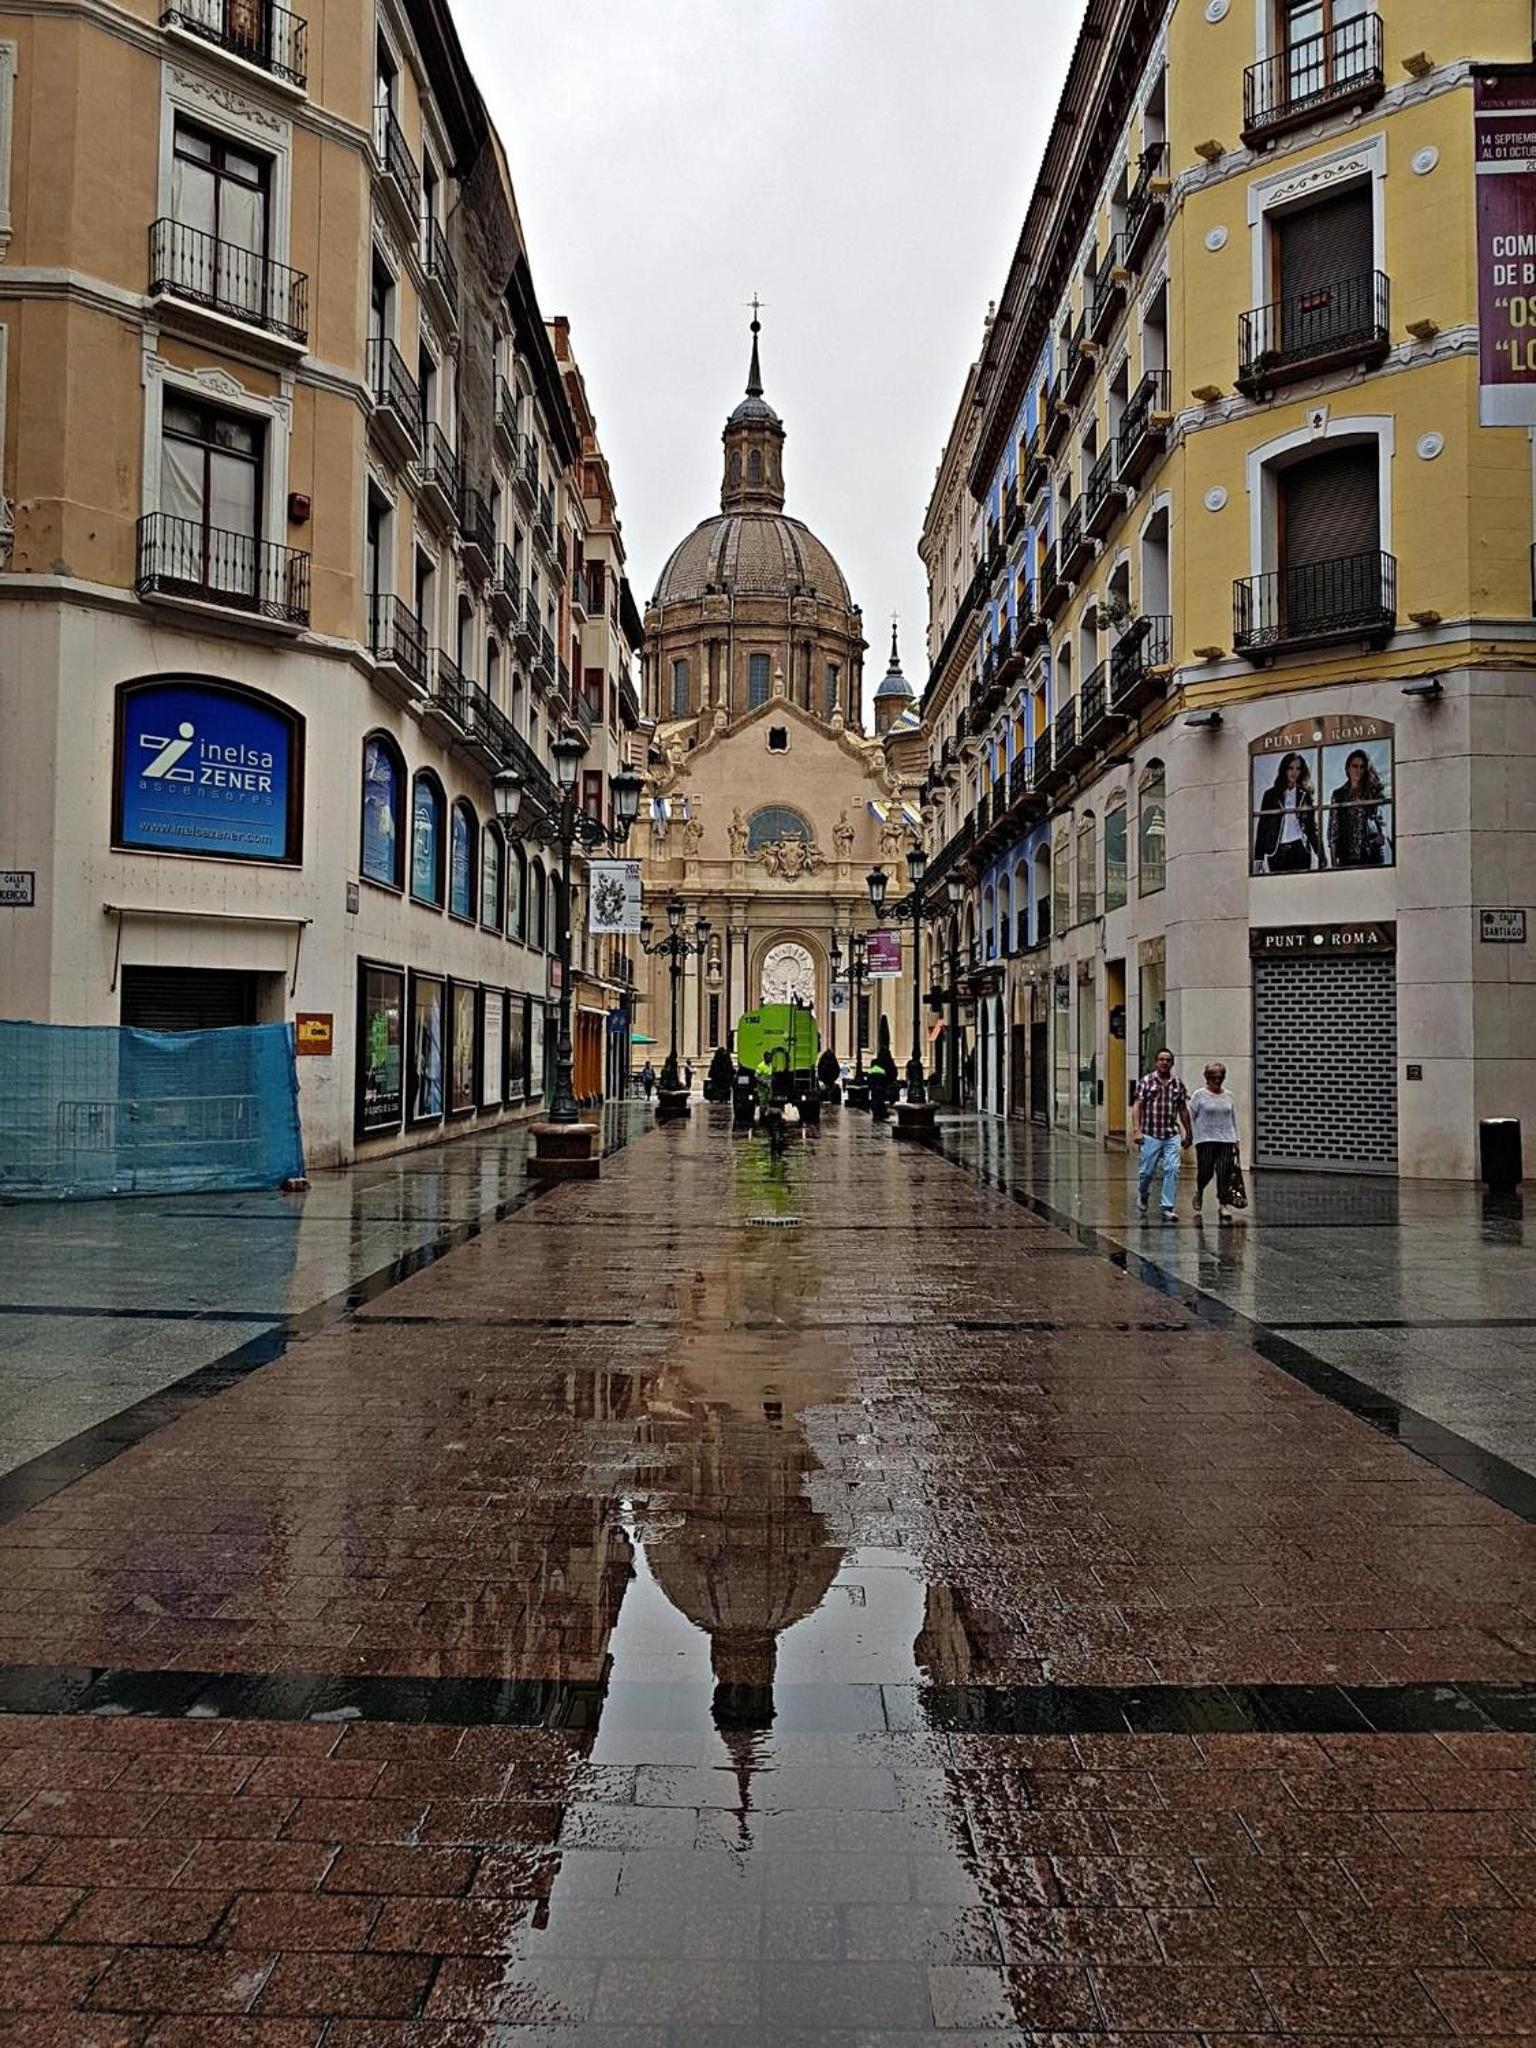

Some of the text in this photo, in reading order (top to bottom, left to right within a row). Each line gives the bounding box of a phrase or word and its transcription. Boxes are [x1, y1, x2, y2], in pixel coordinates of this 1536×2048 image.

[1481, 134, 1492, 145] 14
[1482, 147, 1494, 159] AL
[1495, 147, 1507, 158] 01
[1492, 234, 1536, 257] COM
[1493, 264, 1518, 286] DE
[1264, 724, 1377, 749] PUNT ROMA
[200, 738, 273, 768] inelsa
[200, 767, 272, 793] ZENER
[139, 779, 273, 806] ascensores
[1265, 932, 1379, 948] PUNT ROMA
[1484, 926, 1522, 937] SANTIAGO
